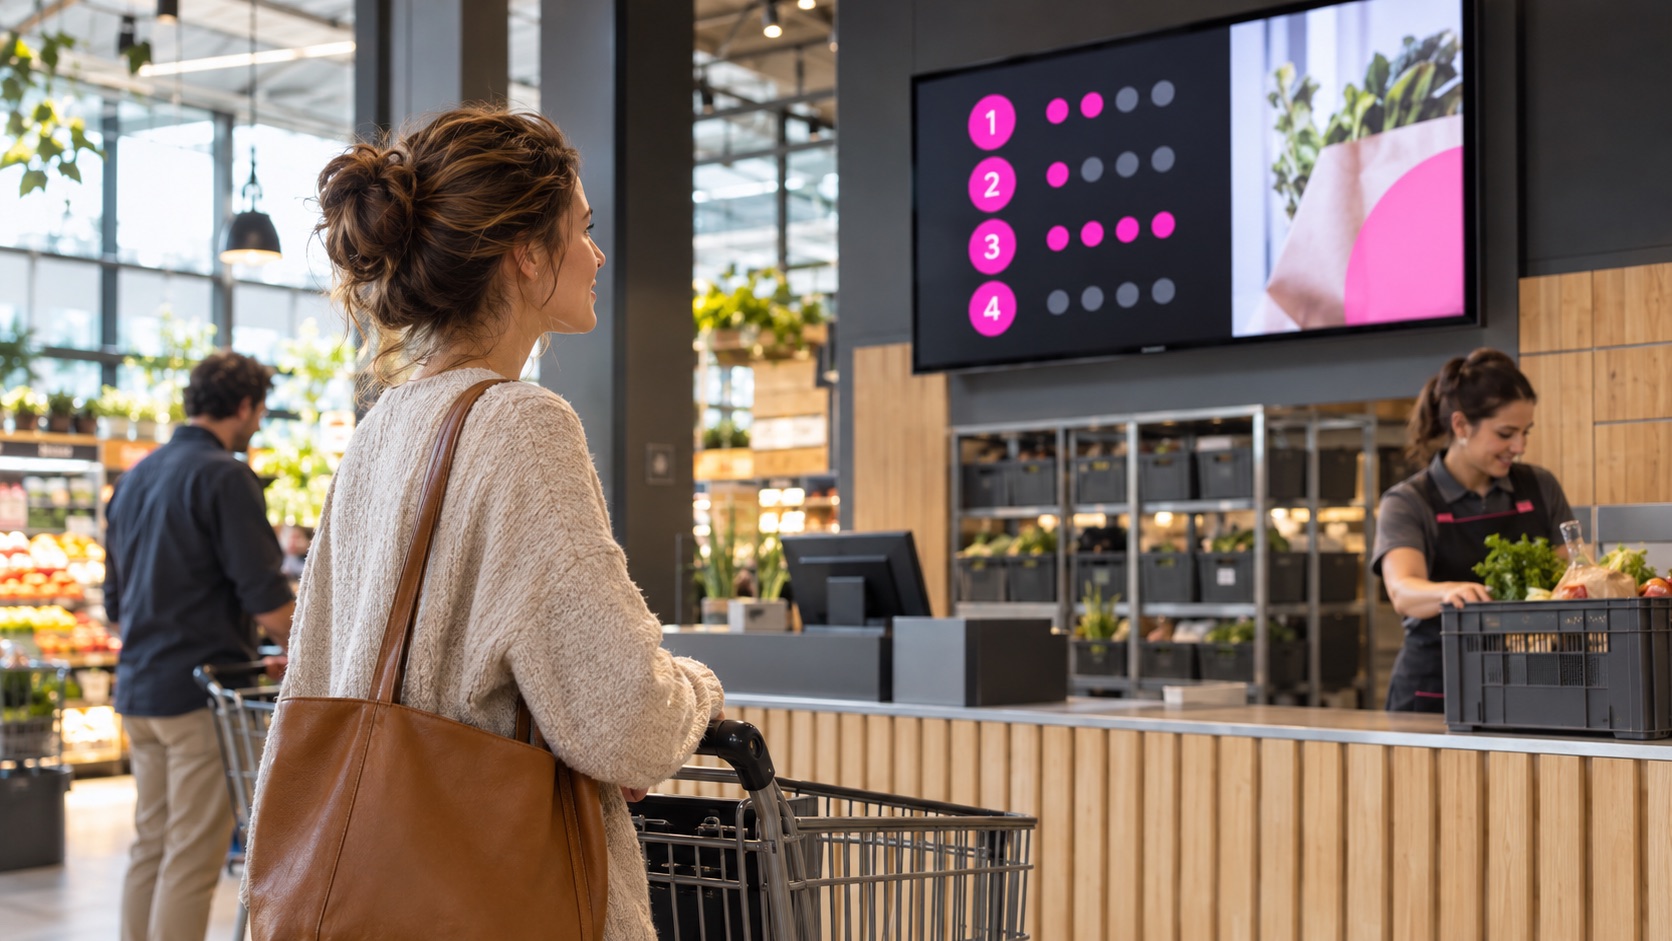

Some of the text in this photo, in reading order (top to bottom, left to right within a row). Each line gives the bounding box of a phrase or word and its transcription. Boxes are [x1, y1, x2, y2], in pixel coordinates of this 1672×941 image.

[985, 109, 996, 136] 1
[984, 171, 1000, 198] 2
[984, 234, 1000, 260] 3
[983, 296, 1001, 321] 4
